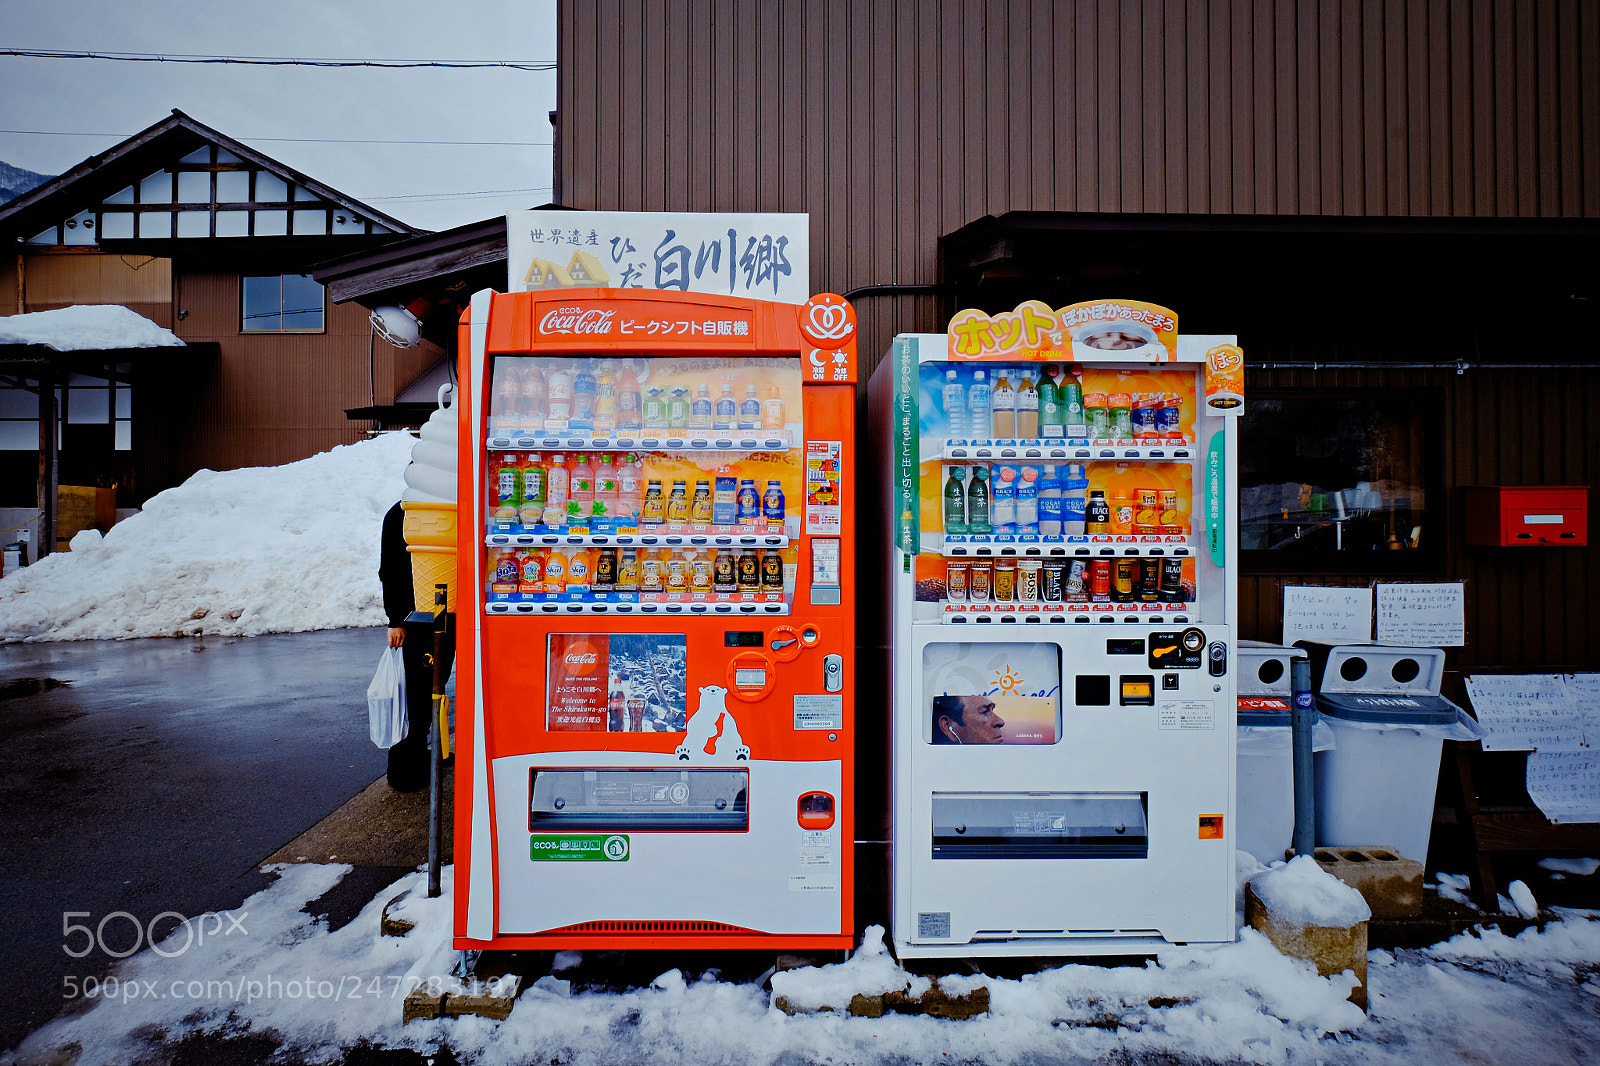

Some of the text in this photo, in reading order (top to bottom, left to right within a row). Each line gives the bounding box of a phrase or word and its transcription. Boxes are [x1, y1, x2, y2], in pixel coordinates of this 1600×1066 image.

[530, 228, 600, 247] 世界遺産
[653, 228, 793, 296] 白川郷
[538, 309, 617, 335] Coca-Cola
[620, 320, 749, 336] ピークシフト自販機
[955, 308, 1054, 355] ホット
[1022, 350, 1063, 358] HOT DRINK
[1210, 352, 1241, 371] ほっ
[953, 487, 963, 508] 生茶
[976, 487, 987, 508] 生茶
[1092, 507, 1109, 515] BLACK
[1028, 572, 1036, 600] BOSS
[1053, 571, 1061, 600] BLACK
[565, 653, 598, 664] Coca-Cola
